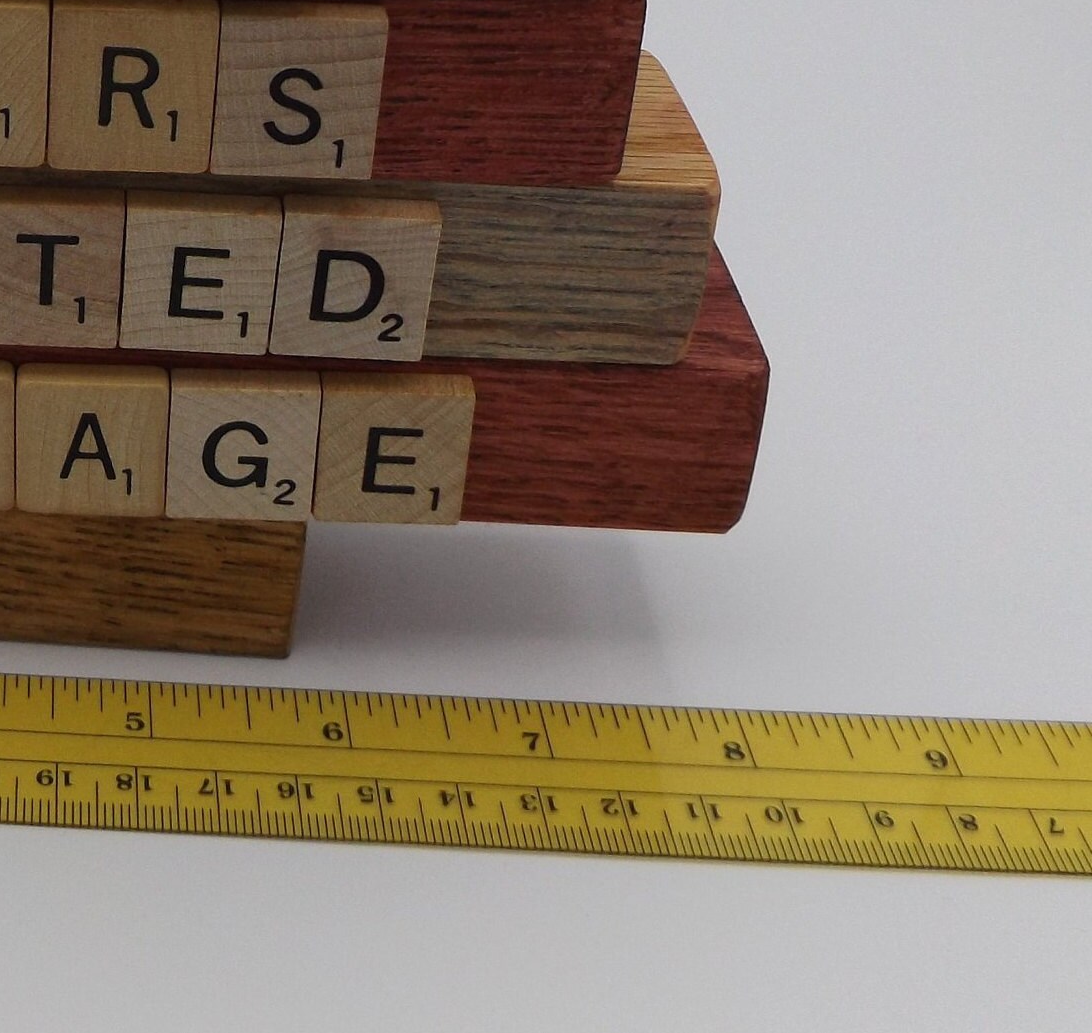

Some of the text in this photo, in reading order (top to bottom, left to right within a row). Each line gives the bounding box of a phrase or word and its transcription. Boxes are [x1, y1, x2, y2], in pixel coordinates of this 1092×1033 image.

[125, 712, 144, 732] 5
[323, 723, 343, 741] 6
[522, 731, 541, 752] 7
[724, 741, 745, 760] 8
[925, 749, 948, 769] 9
[36, 769, 73, 787] 19
[116, 773, 152, 791] 18
[198, 777, 235, 797] 17
[277, 781, 315, 800] 16
[357, 785, 395, 804] 15
[438, 789, 476, 807] 14
[519, 793, 558, 812] 13
[601, 797, 640, 816] 12
[686, 802, 722, 820] 11
[764, 806, 804, 824] 10
[875, 810, 893, 828] 9
[959, 813, 979, 832] 8
[1050, 818, 1065, 835] 7
